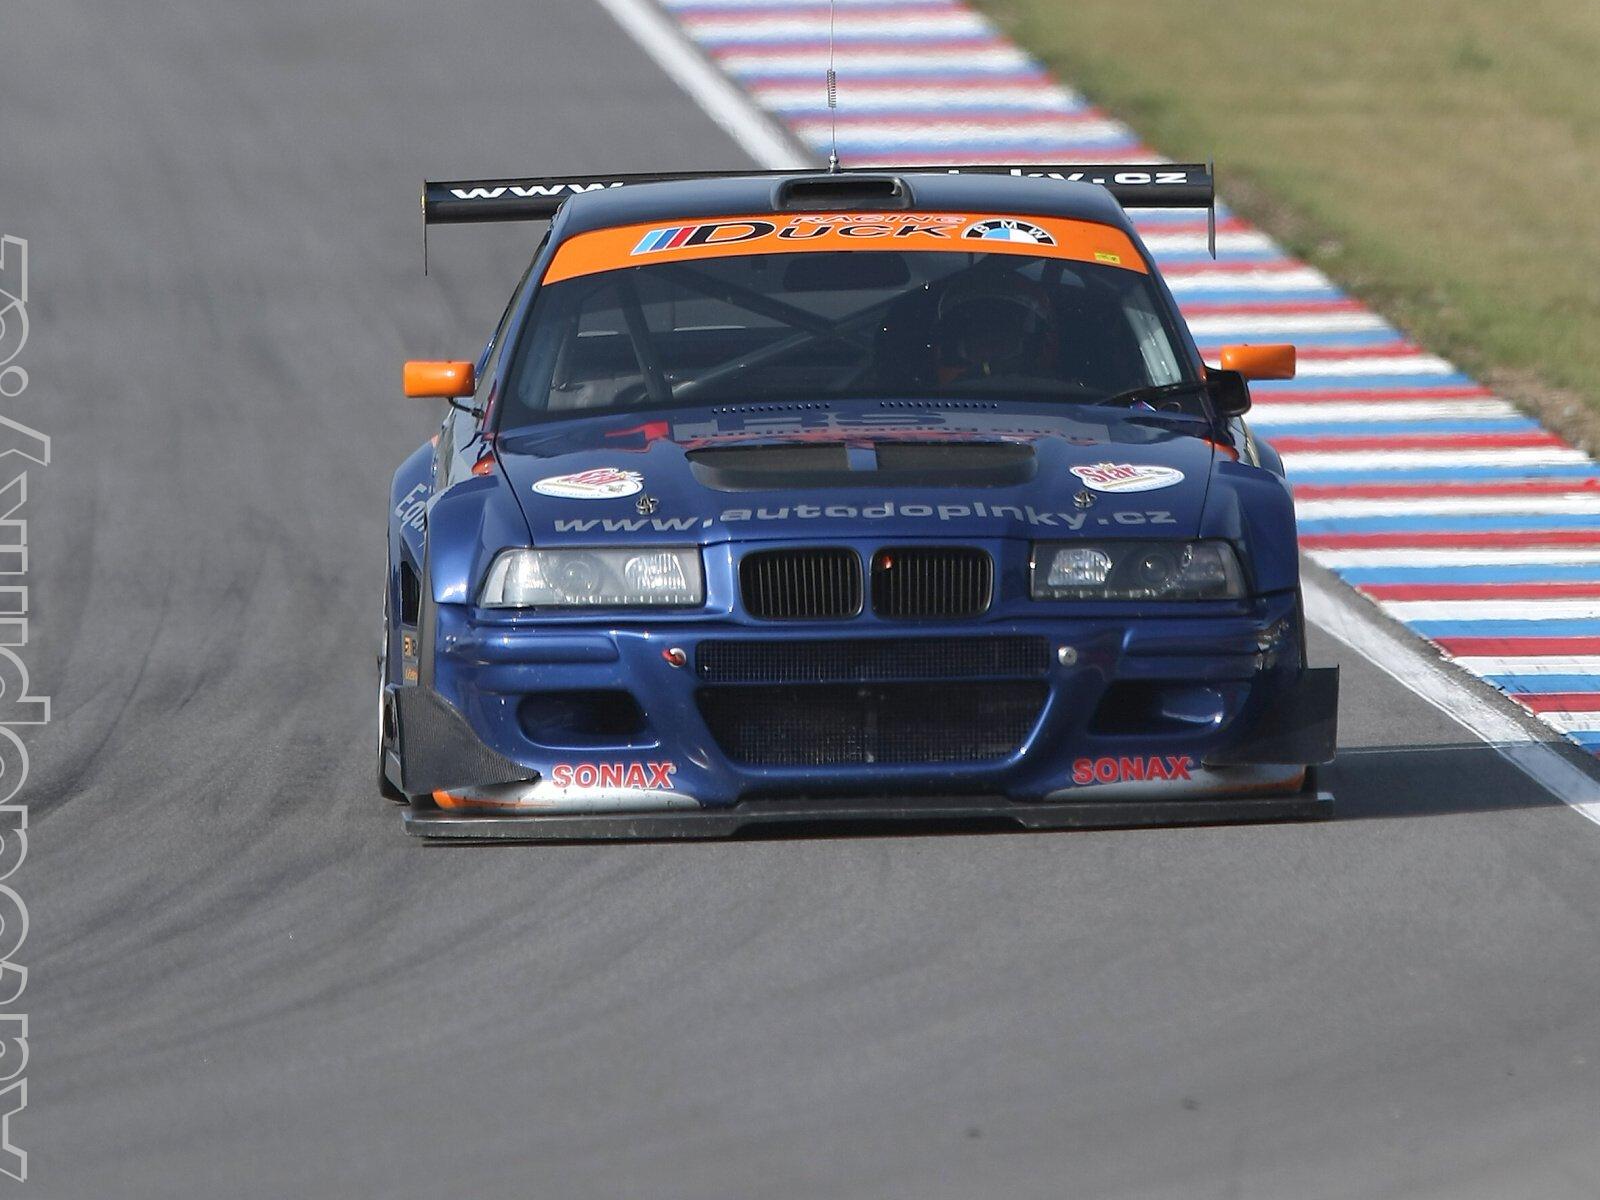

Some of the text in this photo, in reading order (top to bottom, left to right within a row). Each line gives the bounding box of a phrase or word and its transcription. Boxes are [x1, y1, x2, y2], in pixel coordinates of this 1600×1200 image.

[791, 214, 967, 226] RACING
[973, 219, 1048, 239] BMW
[554, 502, 1177, 532] www.autodoplnky.cz
[552, 763, 674, 789] SONAX
[1072, 756, 1192, 785] SONAX
